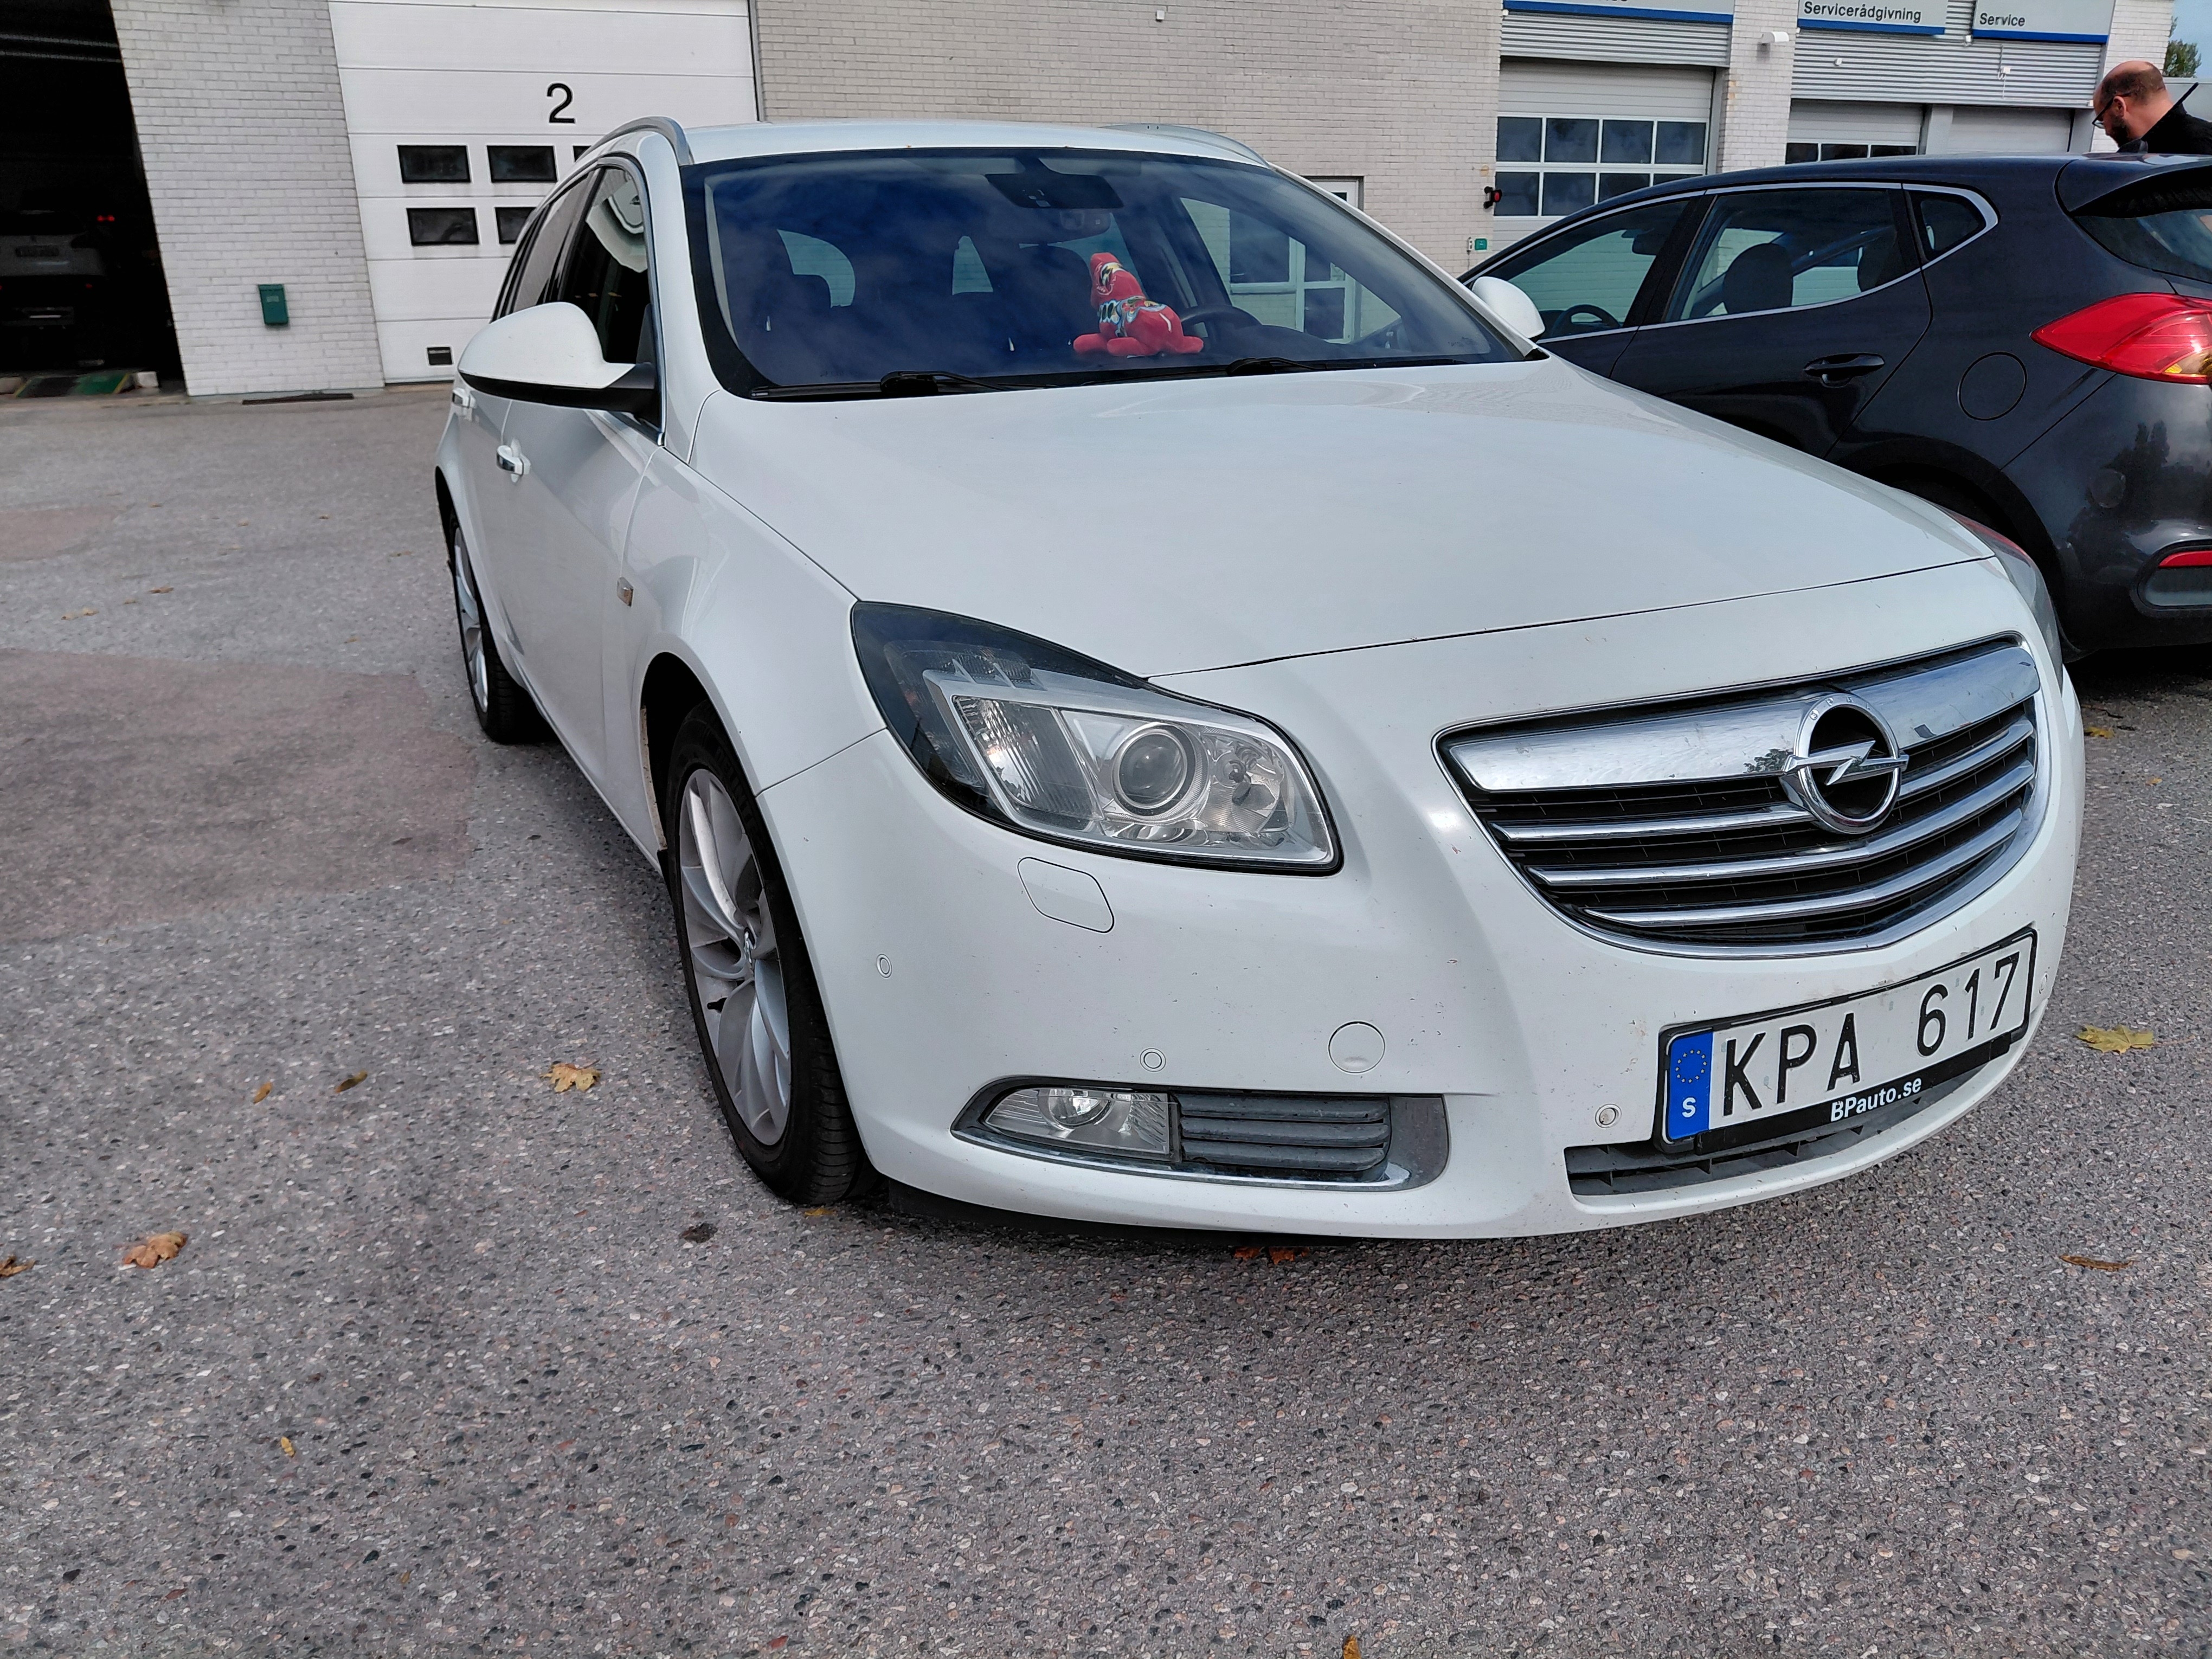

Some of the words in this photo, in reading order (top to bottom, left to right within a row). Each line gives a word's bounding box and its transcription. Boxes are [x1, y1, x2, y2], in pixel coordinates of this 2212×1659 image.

[1804, 1, 1921, 23] Servicerådgivning
[1979, 12, 2025, 27] Service
[547, 82, 576, 124] 2
[1723, 1012, 1861, 1117] KPA
[1917, 951, 2020, 1057] 617
[1682, 1096, 1696, 1118] S
[1830, 1077, 1922, 1122] BPauto.se
